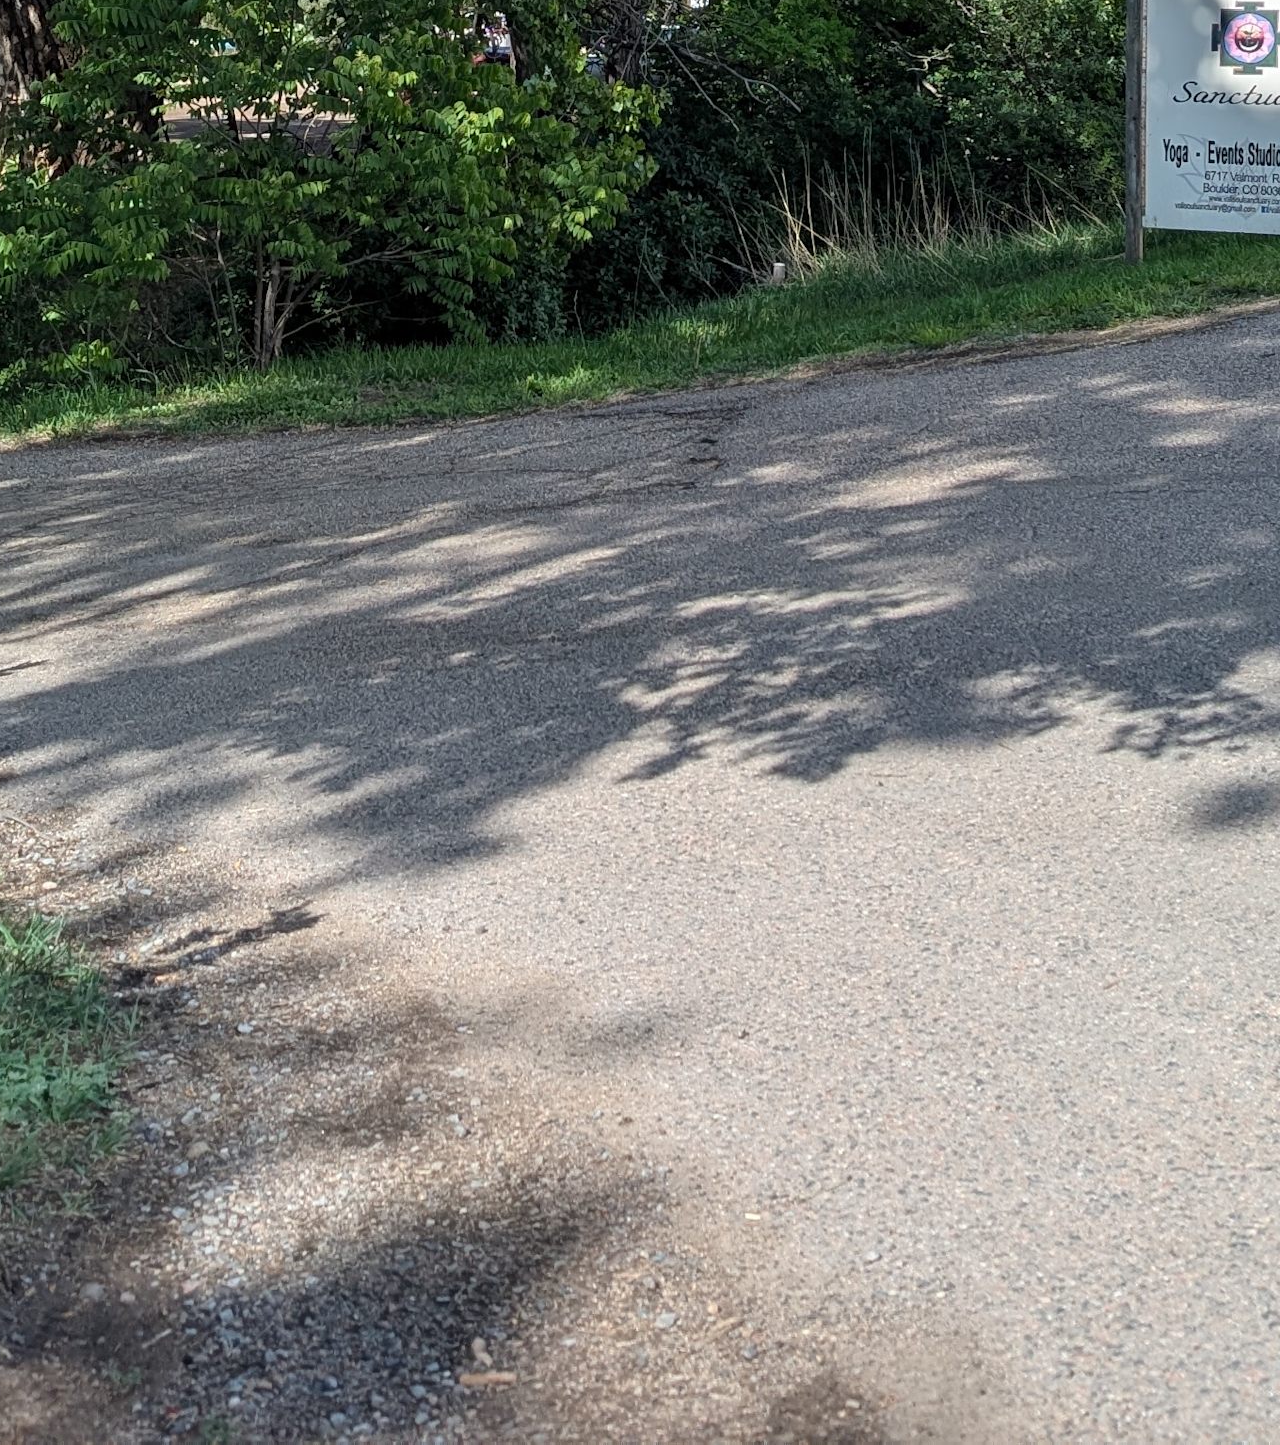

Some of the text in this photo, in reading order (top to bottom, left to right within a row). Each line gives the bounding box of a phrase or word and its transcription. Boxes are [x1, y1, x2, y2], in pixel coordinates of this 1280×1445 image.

[1163, 139, 1189, 168] Yoga
[1208, 141, 1244, 166] Events
[1204, 171, 1228, 181] 6717
[1230, 172, 1268, 183] Valmont
[1203, 183, 1240, 195] Boulder,
[1243, 184, 1259, 195] CO
